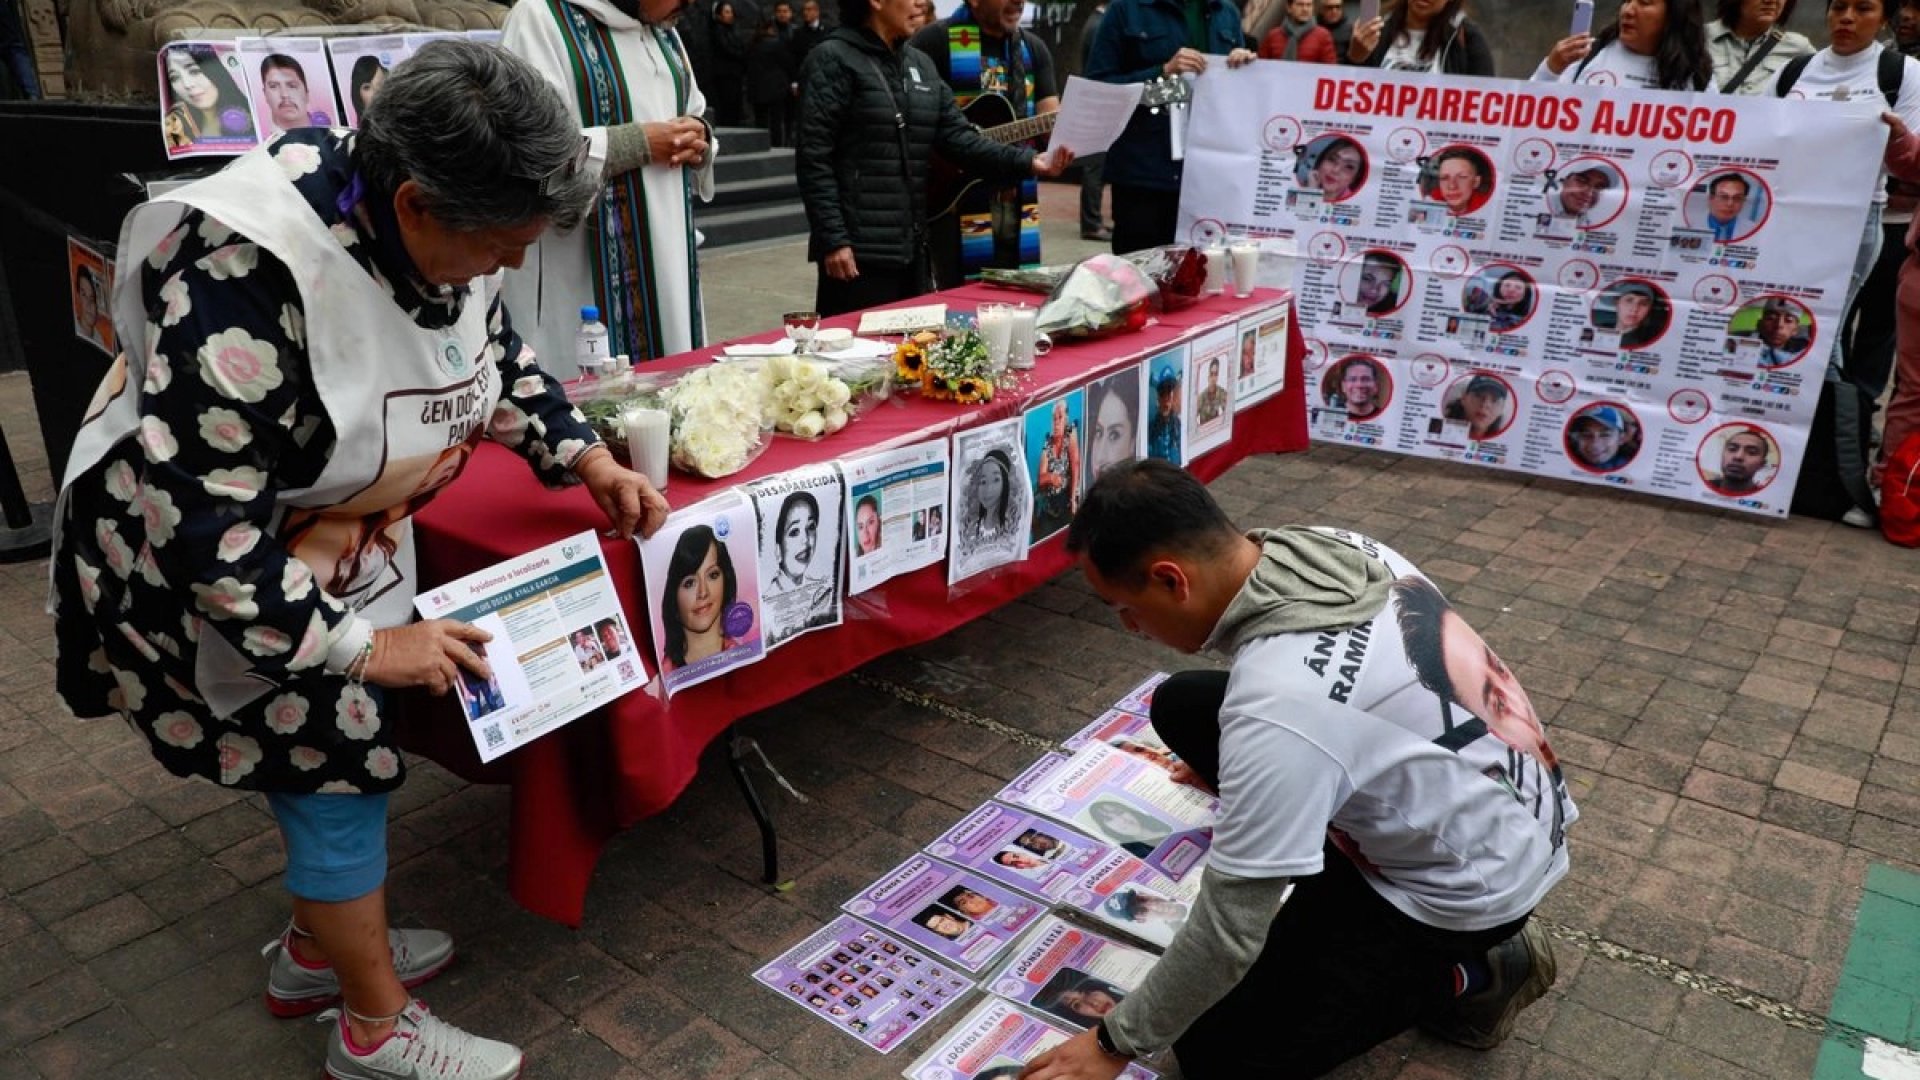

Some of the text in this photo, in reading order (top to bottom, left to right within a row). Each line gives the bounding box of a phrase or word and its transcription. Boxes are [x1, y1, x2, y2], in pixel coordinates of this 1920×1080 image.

[1313, 78, 1737, 145] DESAPARECIDOS AJUSCO
[421, 399, 454, 425] ¿EN
[757, 474, 836, 498] DESAPARECIDA
[1303, 630, 1340, 677] ÁN
[1016, 946, 1046, 977] ¿DÓNDE
[945, 1031, 982, 1065] ¿DÓNDE
